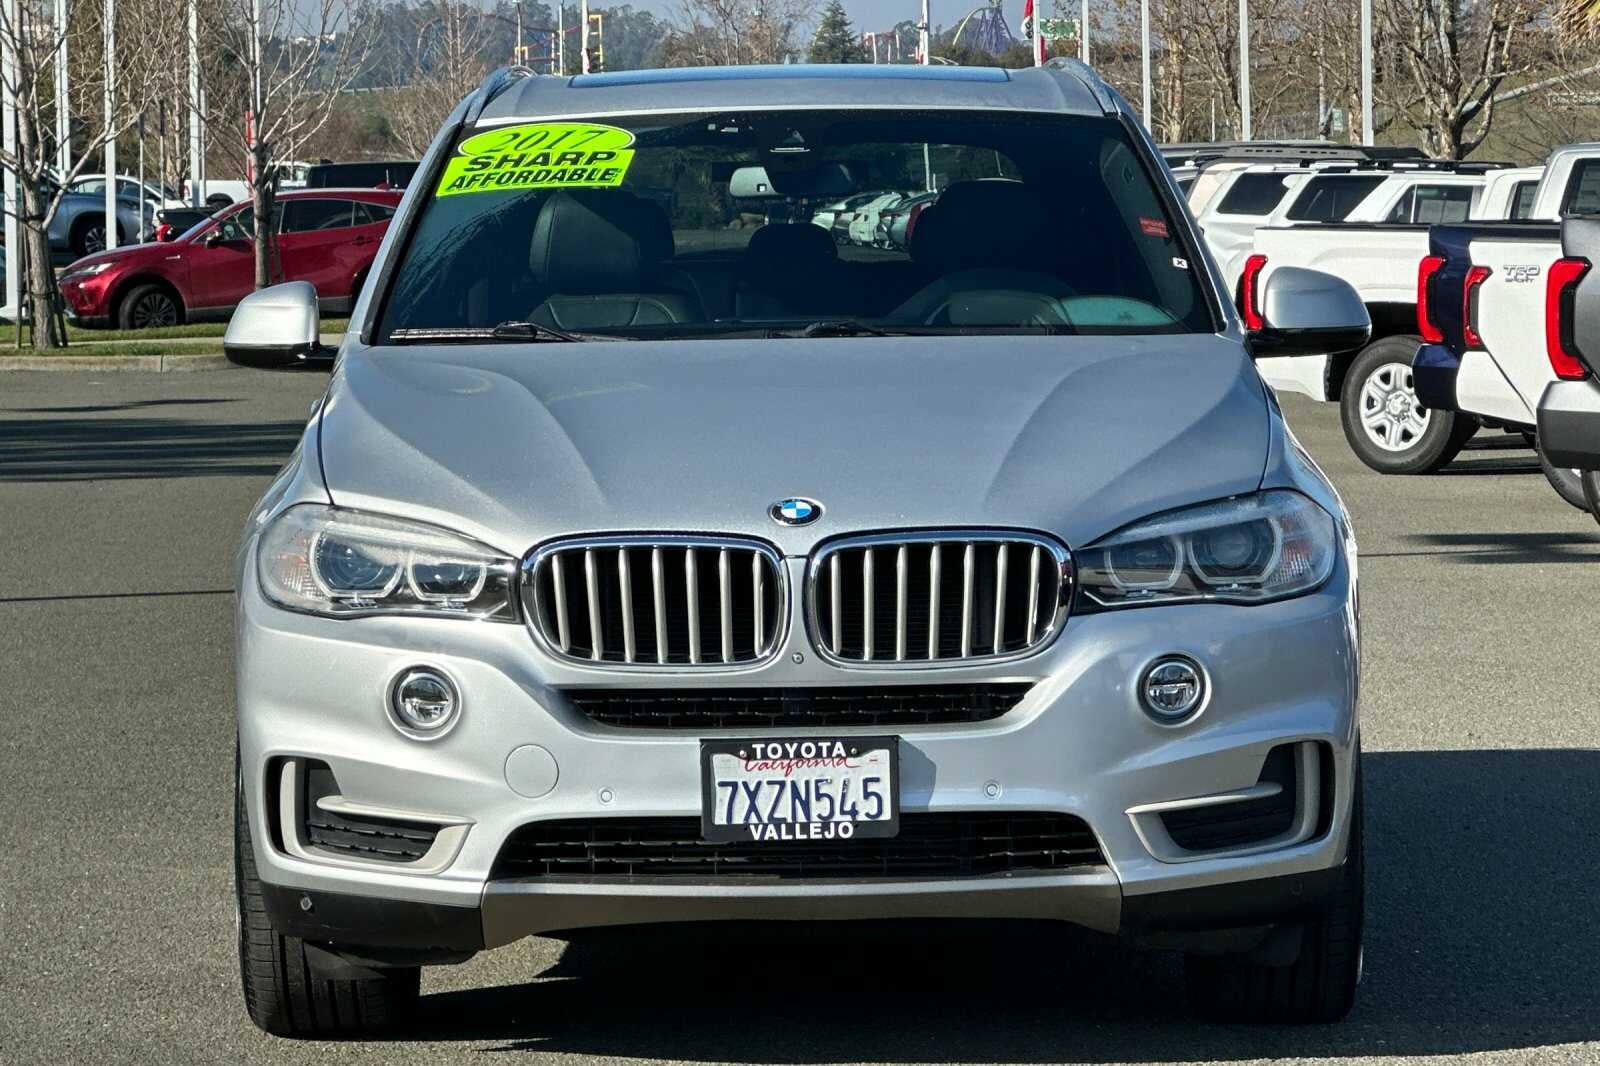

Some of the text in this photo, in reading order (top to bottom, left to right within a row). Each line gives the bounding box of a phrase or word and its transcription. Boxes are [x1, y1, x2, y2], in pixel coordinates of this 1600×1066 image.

[485, 129, 608, 153] 2017
[463, 151, 617, 172] SHARP
[447, 168, 620, 191] AFFORDABLE
[752, 741, 847, 759] TOYOTA
[717, 777, 883, 825] 7XZN545
[749, 822, 854, 841] VALLEJO
